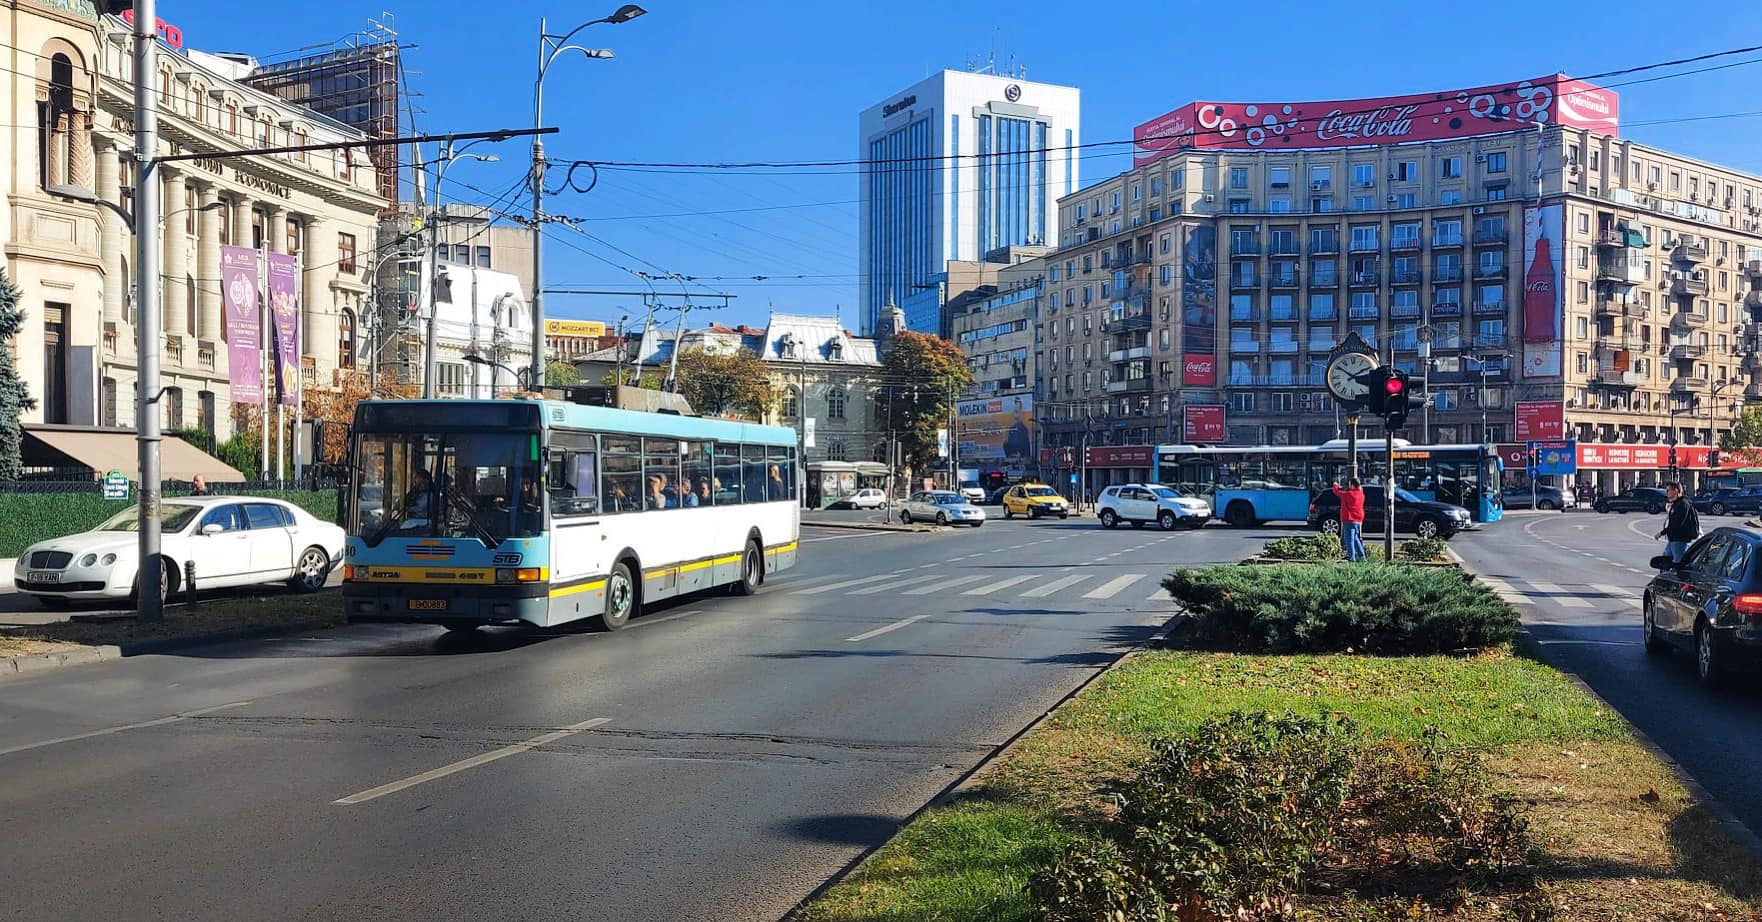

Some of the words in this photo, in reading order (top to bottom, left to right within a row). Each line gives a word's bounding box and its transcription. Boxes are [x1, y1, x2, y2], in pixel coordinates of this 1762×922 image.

[1317, 105, 1420, 140] Coca-Cola
[234, 169, 292, 200] ECONOMICE
[1186, 361, 1212, 374] Coca-Cola
[959, 402, 988, 417] MOLEKIN
[491, 553, 520, 567] STB
